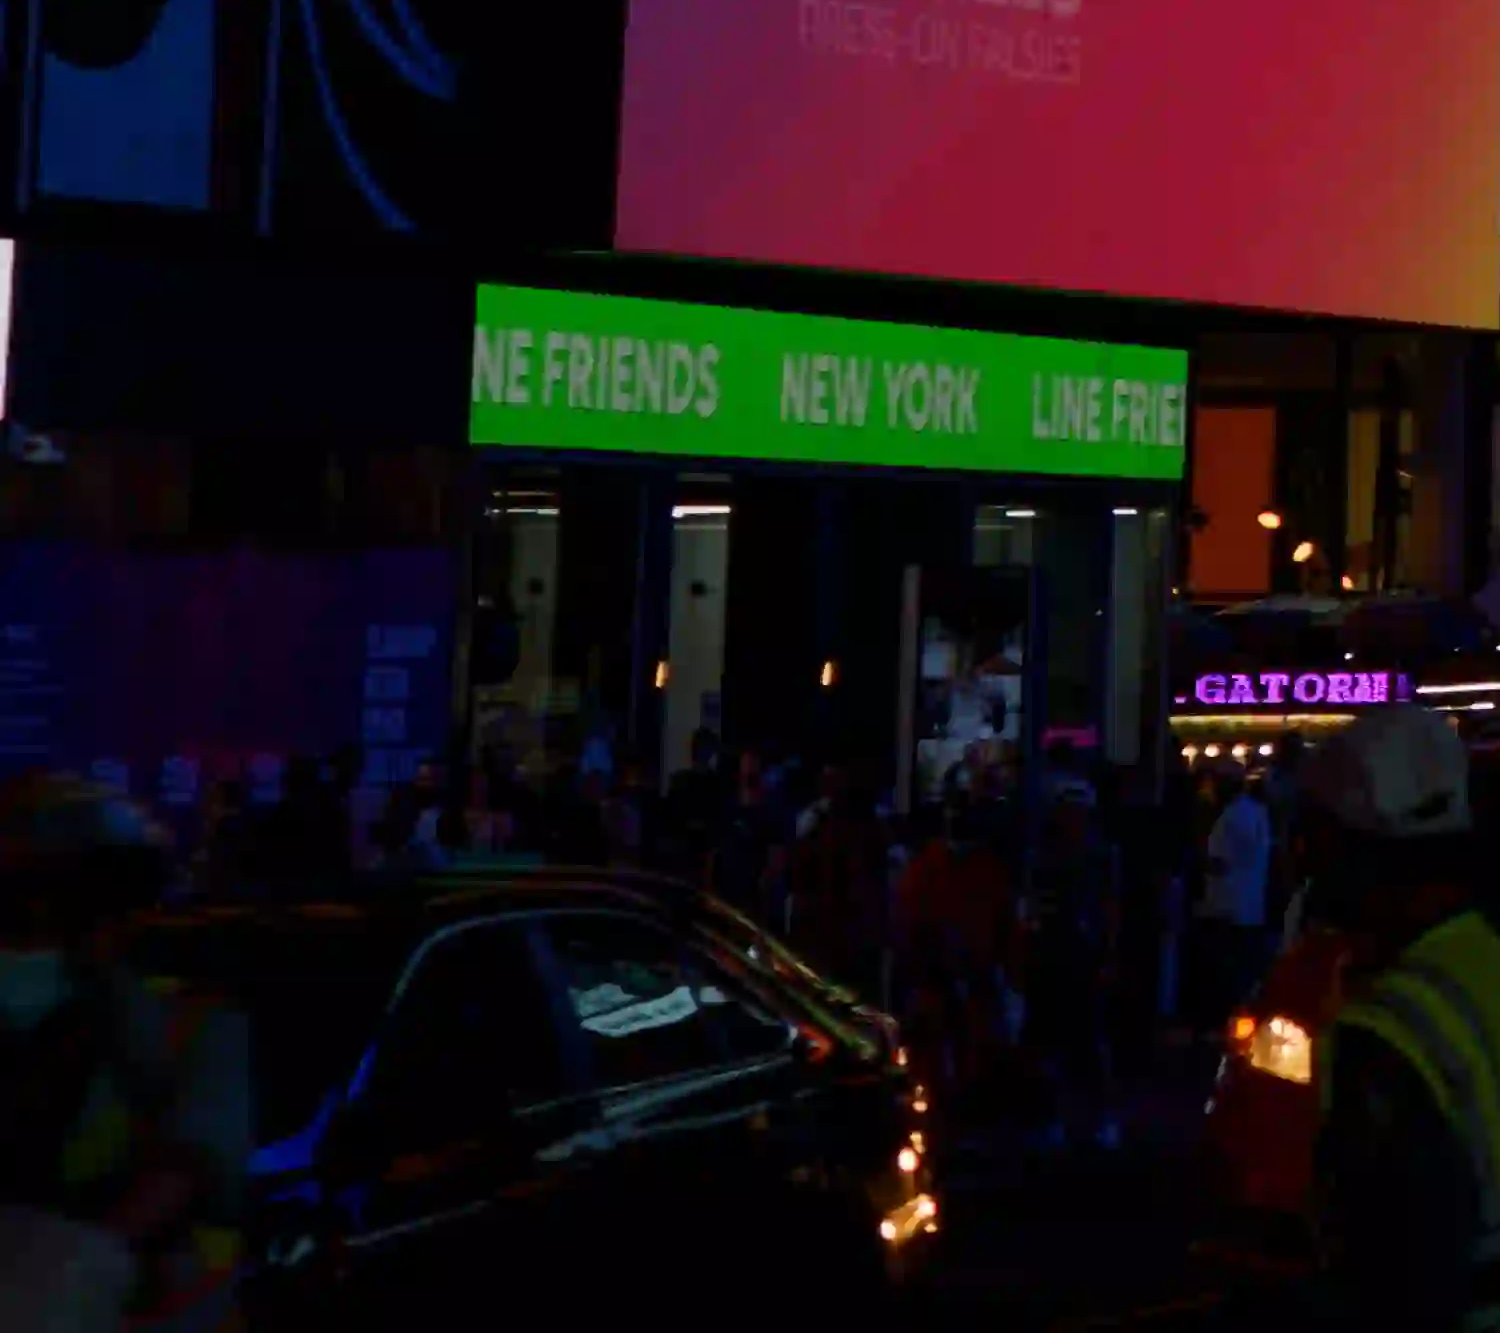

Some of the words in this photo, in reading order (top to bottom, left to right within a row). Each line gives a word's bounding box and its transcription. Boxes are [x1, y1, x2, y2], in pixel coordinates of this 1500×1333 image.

[544, 330, 724, 419] FRIENDS
[781, 351, 873, 426] NEW
[880, 362, 982, 432] YORK
[1030, 371, 1107, 443] LINE
